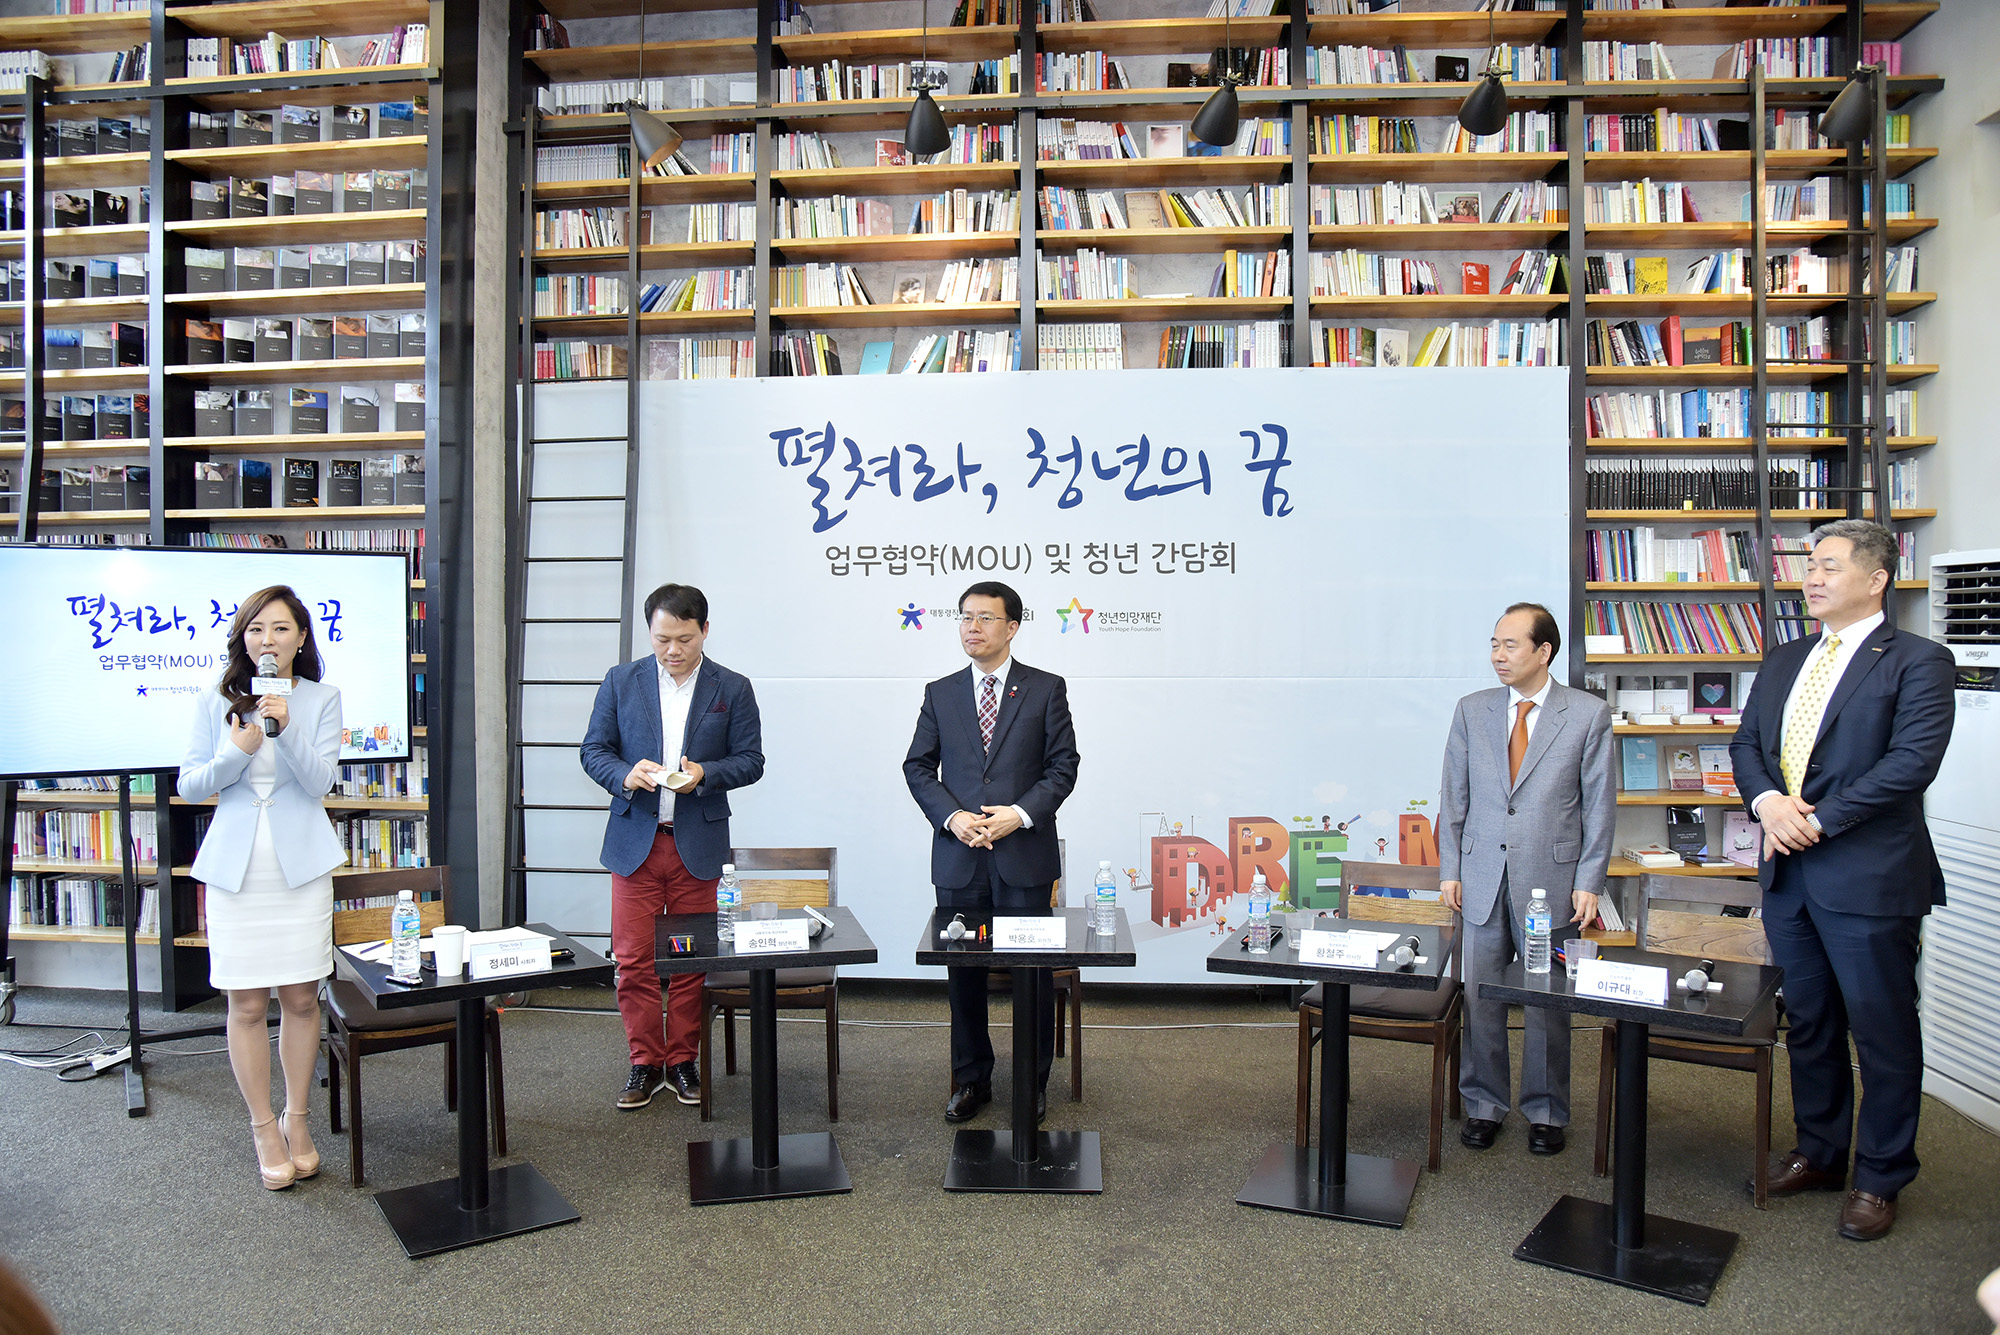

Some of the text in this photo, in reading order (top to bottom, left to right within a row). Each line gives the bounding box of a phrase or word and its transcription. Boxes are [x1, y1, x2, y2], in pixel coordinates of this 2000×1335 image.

[769, 420, 1295, 534] 펼쳐라, 청년의 꿈
[825, 542, 1237, 577] 업무협약(MOU) 및 청년 간담회
[66, 593, 196, 649] 펼쳐라,
[317, 599, 344, 642] 꿈
[929, 608, 960, 618] 대통령직
[1097, 611, 1162, 625] 청년희망재단
[1115, 626, 1128, 634] Hope
[99, 653, 214, 671] 업무협약(MOU)
[1965, 650, 1989, 660] WHISEN
[341, 725, 389, 752] REAM
[489, 955, 519, 970] 정세미
[1598, 980, 1631, 994] 이규대
